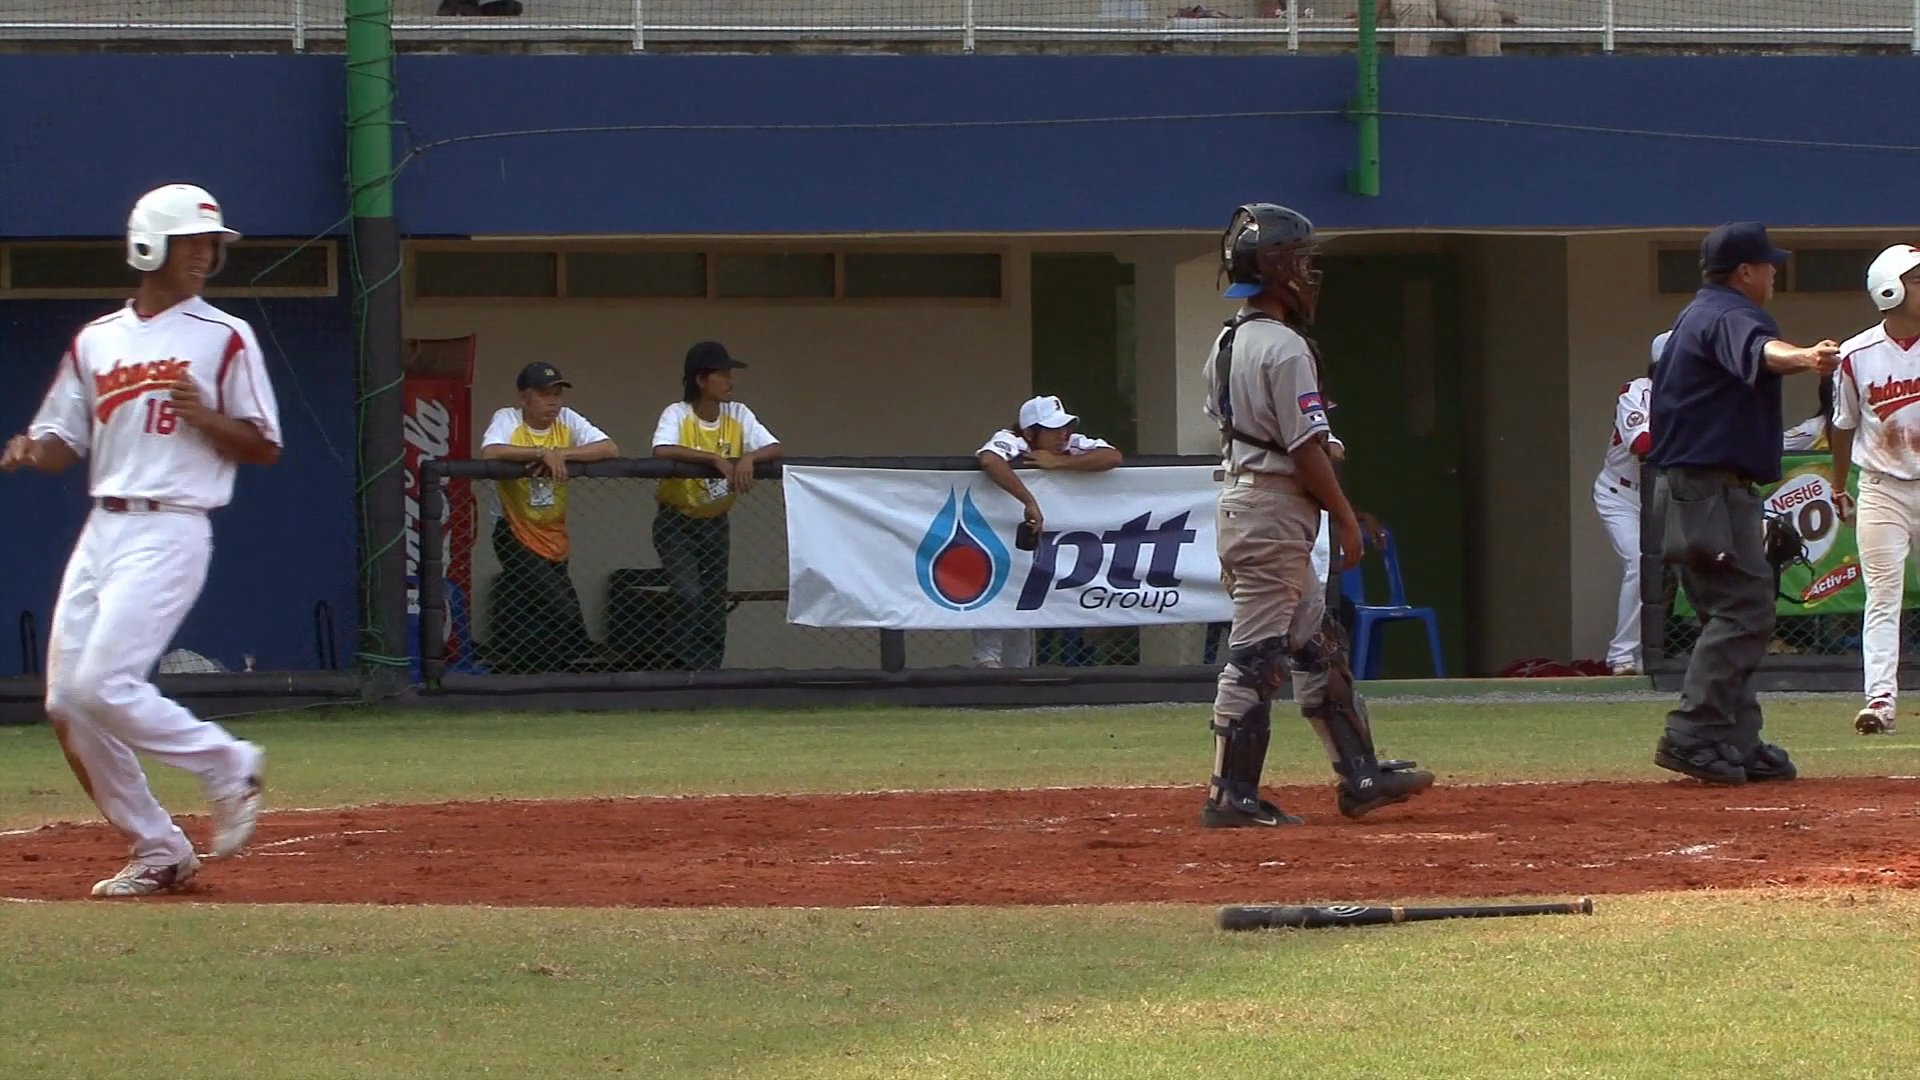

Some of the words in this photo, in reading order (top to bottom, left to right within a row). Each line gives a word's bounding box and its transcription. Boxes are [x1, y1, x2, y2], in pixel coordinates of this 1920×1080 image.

[1016, 510, 1197, 611] ptt
[1810, 566, 1858, 595] Activ-B
[1079, 586, 1180, 614] Group
